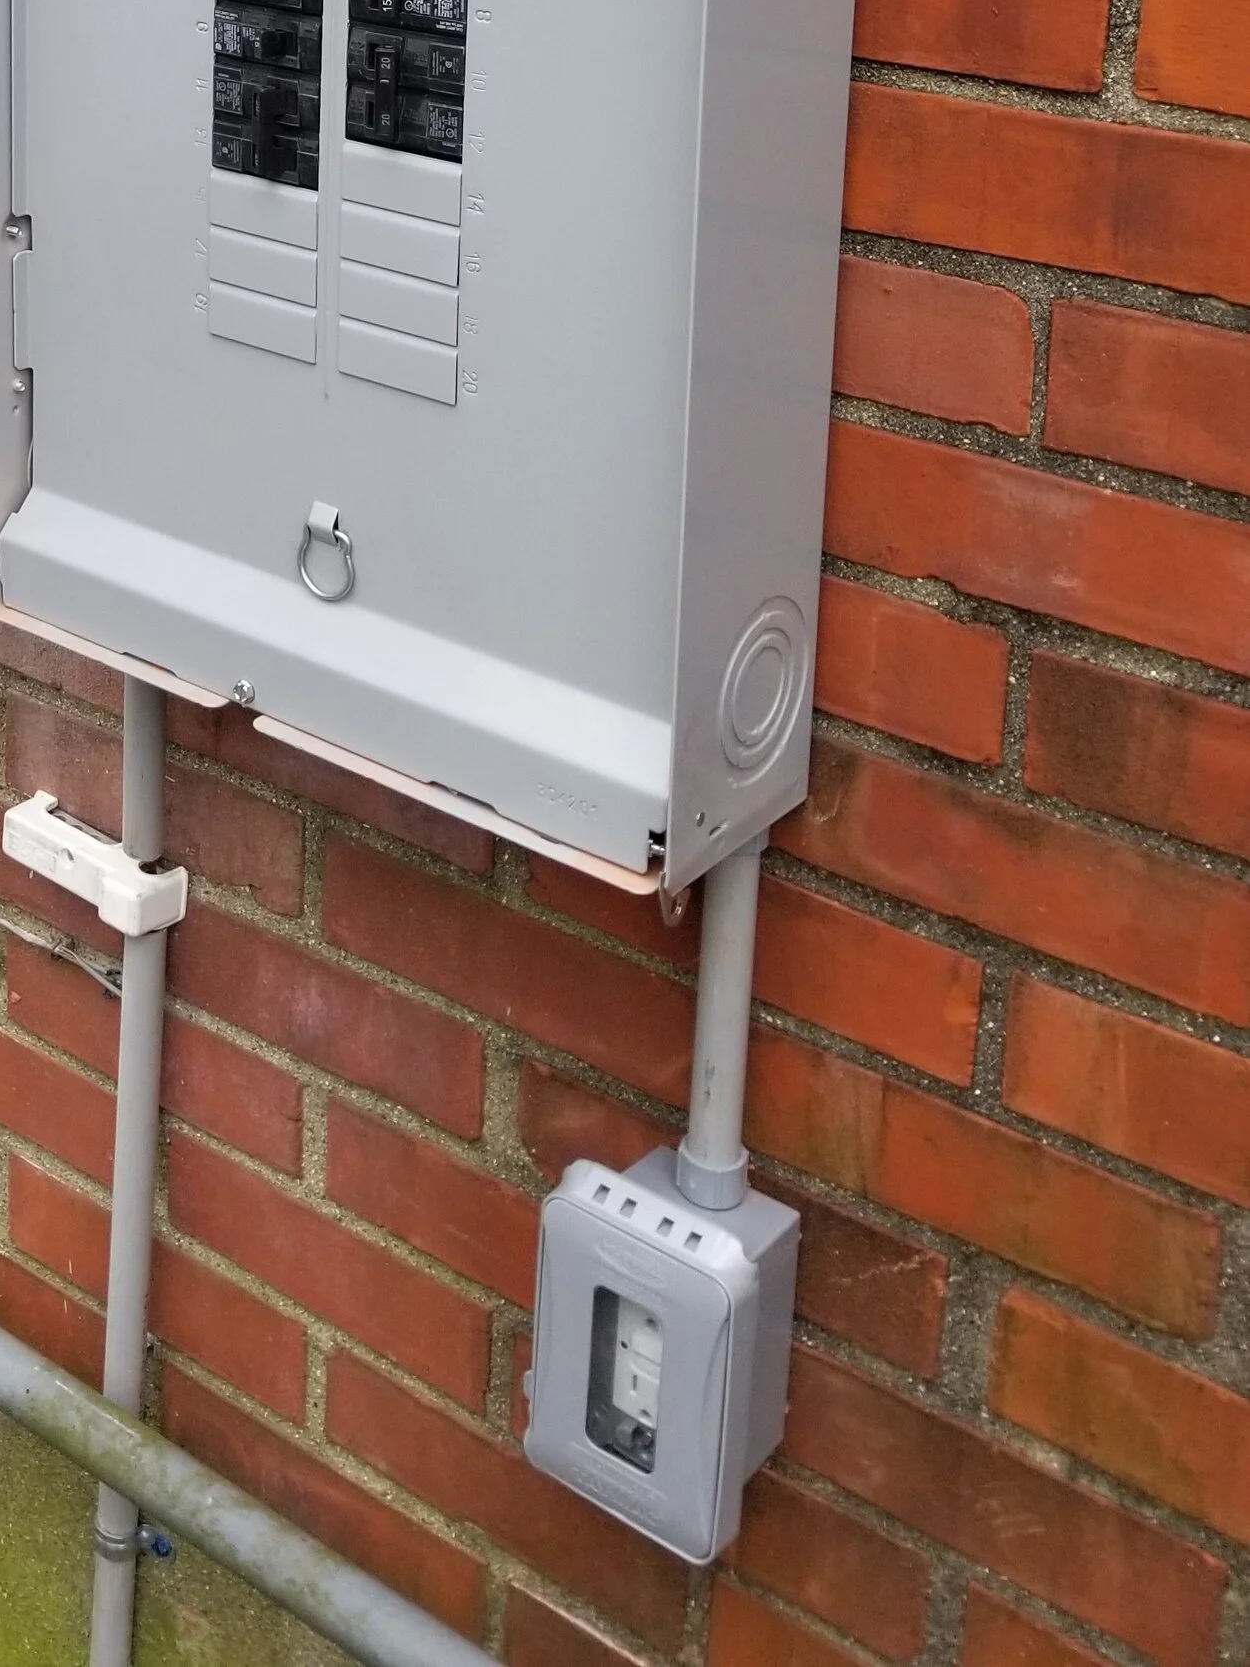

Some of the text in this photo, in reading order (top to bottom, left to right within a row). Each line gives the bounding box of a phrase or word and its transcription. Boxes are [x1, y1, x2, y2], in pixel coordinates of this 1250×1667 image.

[474, 9, 492, 23] 8
[196, 21, 209, 33] 9
[381, 57, 391, 70] 20
[195, 77, 210, 93] 11
[469, 70, 487, 92] 10
[381, 113, 391, 127] 20
[193, 127, 207, 147] 13
[468, 131, 487, 154] 12
[465, 193, 486, 215] 14
[464, 252, 482, 275] 16
[193, 293, 209, 314] 19
[462, 315, 479, 336] 18
[461, 369, 479, 396] 20
